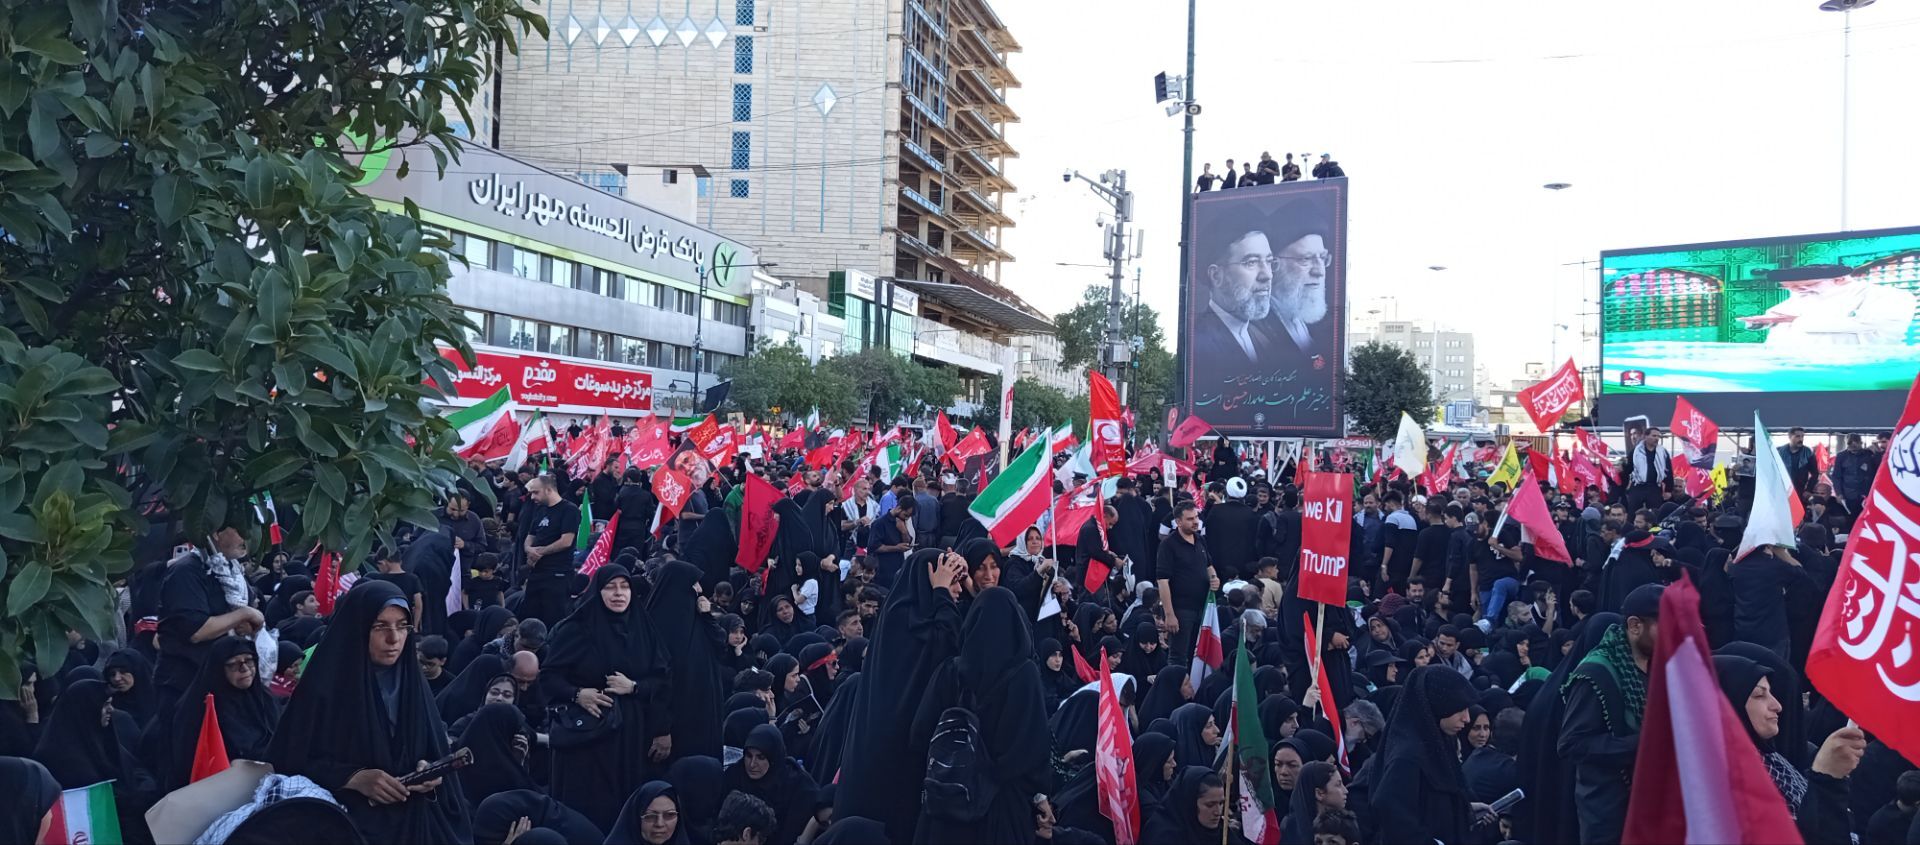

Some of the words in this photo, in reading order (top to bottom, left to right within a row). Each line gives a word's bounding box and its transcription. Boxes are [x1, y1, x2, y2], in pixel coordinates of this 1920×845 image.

[471, 173, 524, 216] ایران
[525, 193, 566, 226] مهر
[569, 203, 632, 242] الحسنه
[634, 226, 669, 259] قرض
[672, 235, 705, 272] بانک
[522, 360, 557, 389] مقدم
[574, 373, 612, 398] سوغات
[611, 378, 633, 401] خرید
[630, 379, 651, 401] مرکز
[1305, 501, 1323, 520] we
[1325, 497, 1343, 523] Kill
